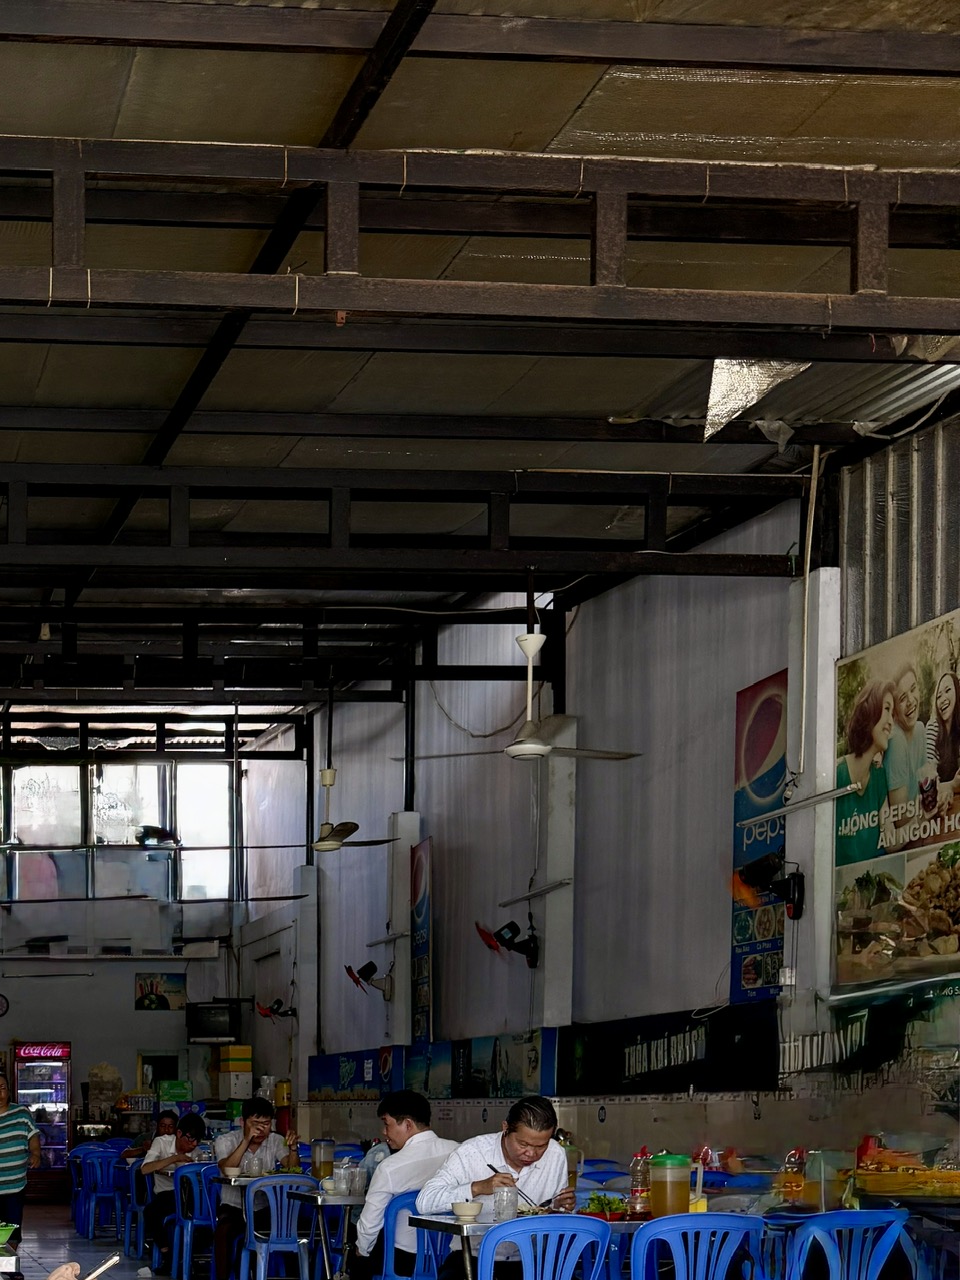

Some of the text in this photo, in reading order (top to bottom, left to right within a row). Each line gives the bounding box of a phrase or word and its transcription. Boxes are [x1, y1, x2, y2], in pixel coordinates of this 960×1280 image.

[743, 815, 785, 851] peps
[877, 825, 897, 850] ĂN
[900, 819, 940, 844] NGON
